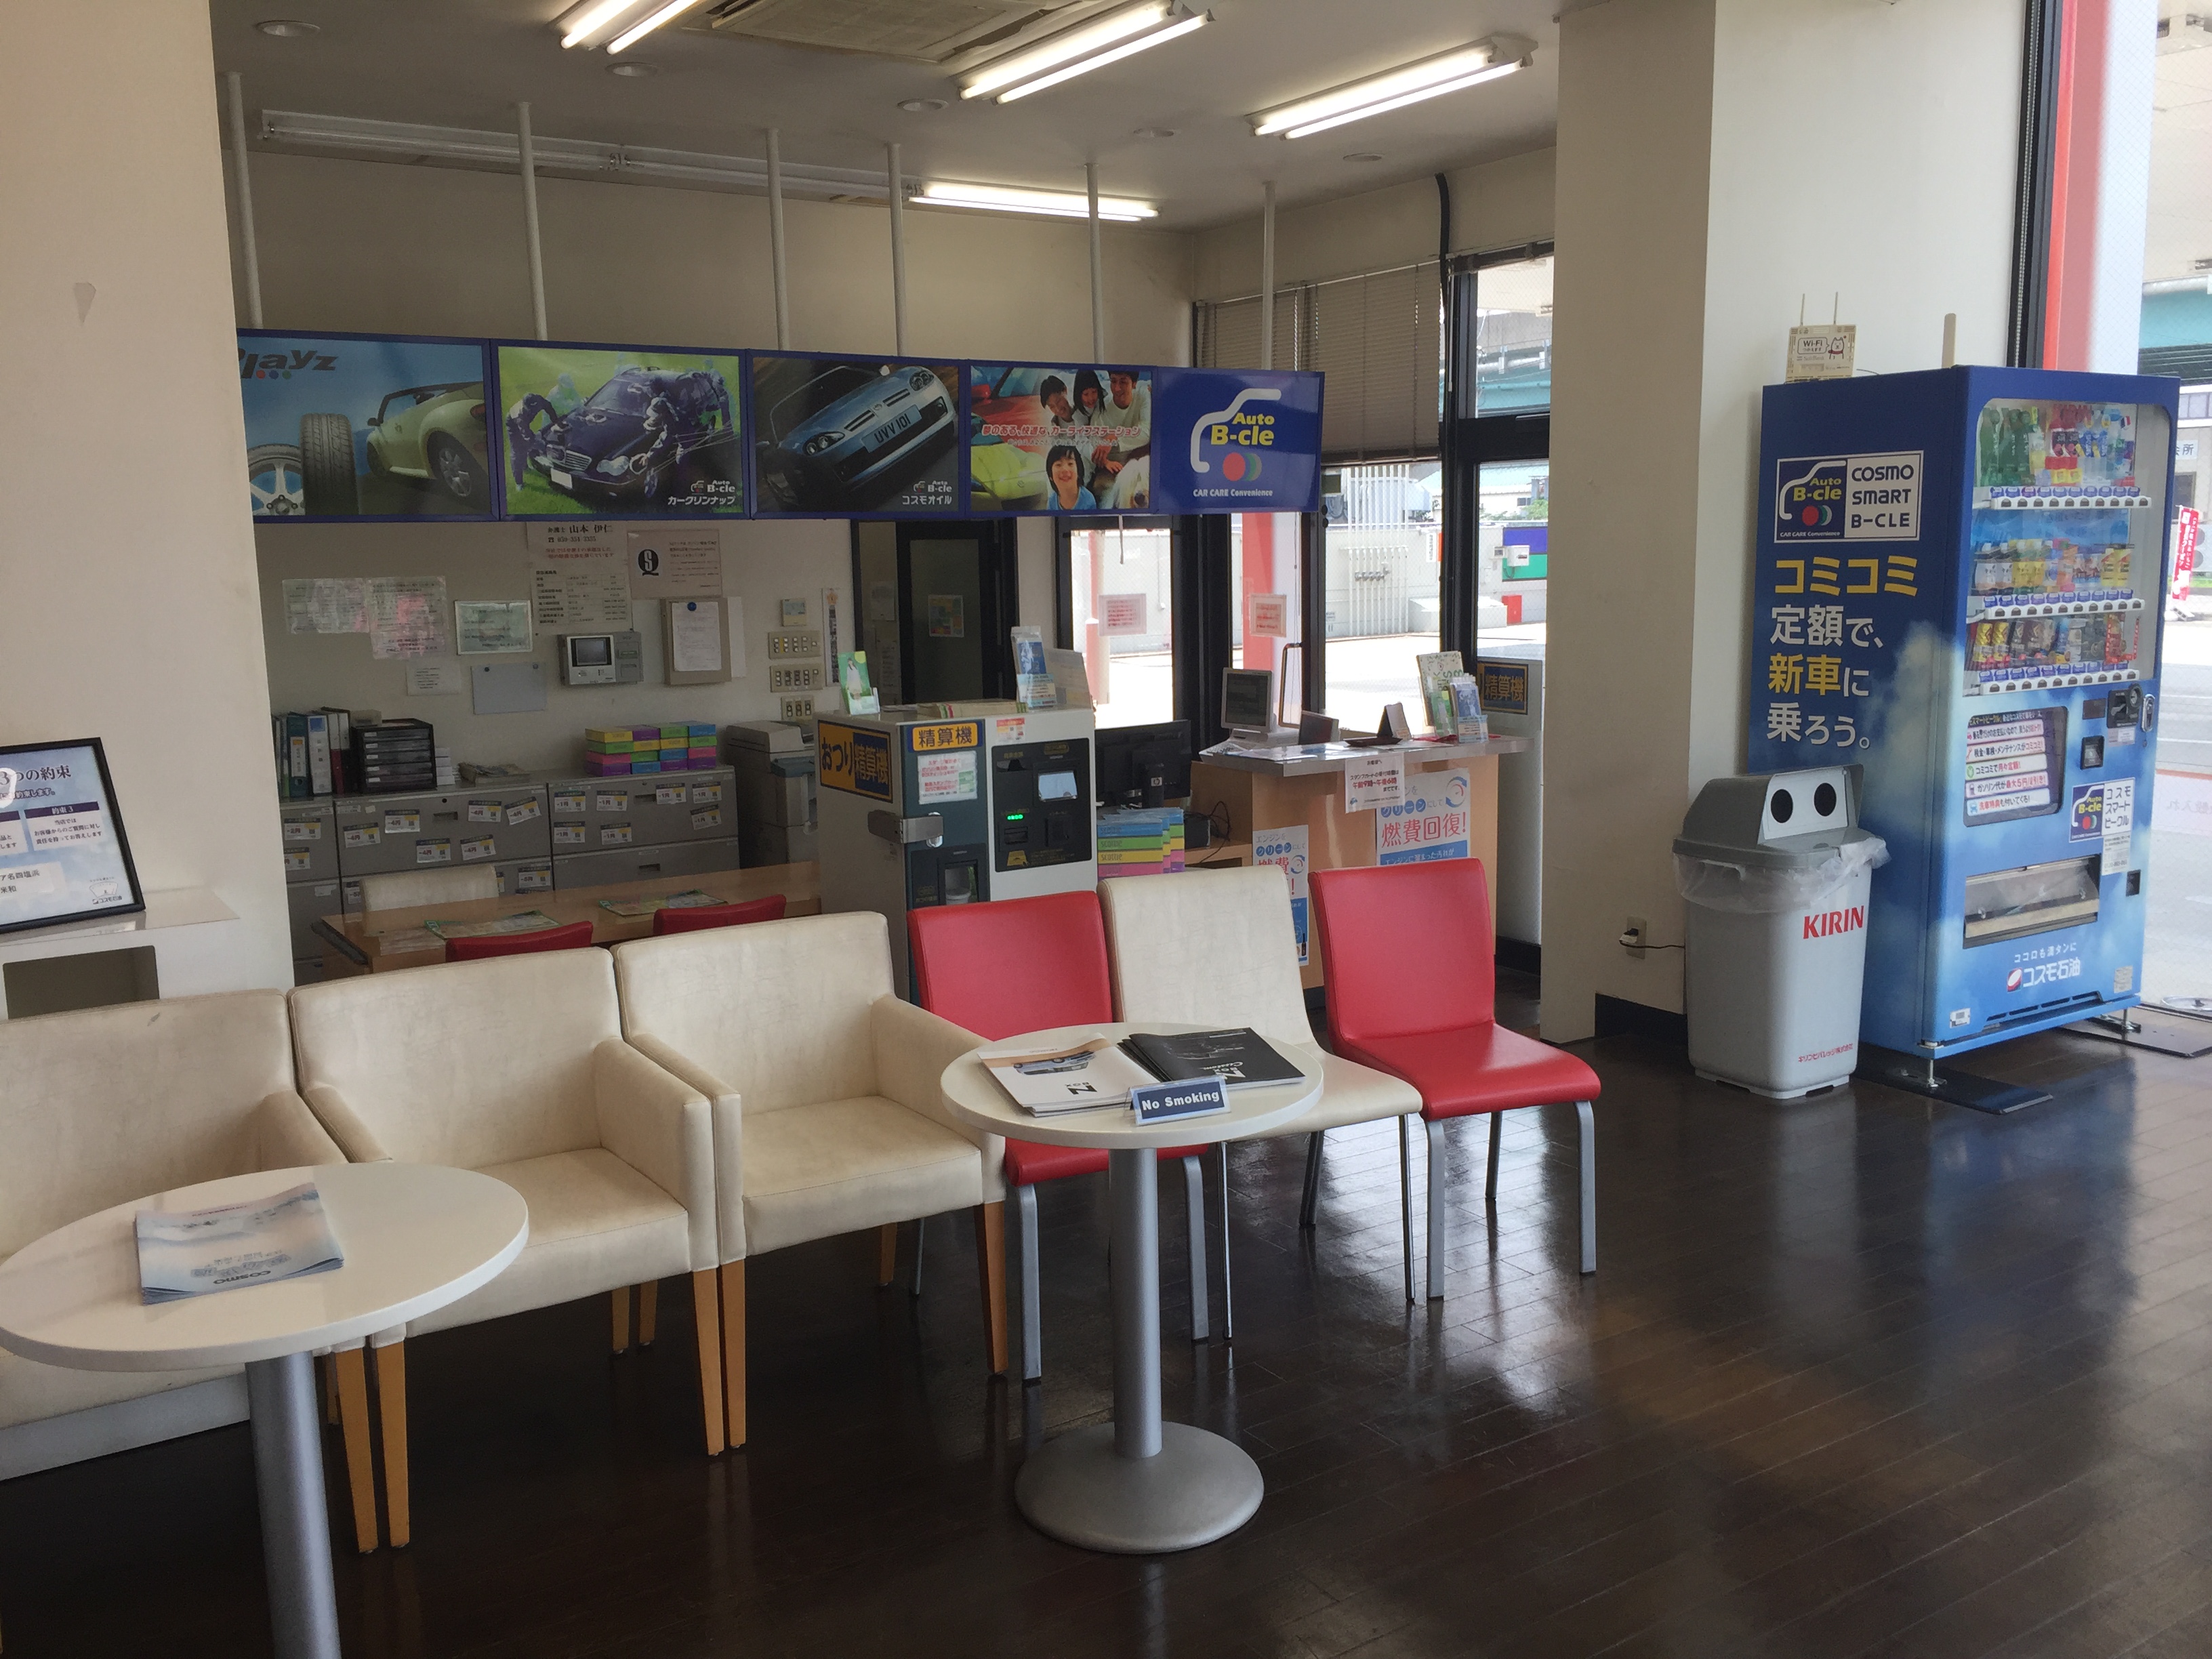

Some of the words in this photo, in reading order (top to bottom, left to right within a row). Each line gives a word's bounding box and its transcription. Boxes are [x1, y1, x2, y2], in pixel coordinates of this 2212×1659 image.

[1231, 412, 1275, 425] Auto
[874, 422, 895, 443] UVV
[1210, 425, 1274, 445] B-cle
[707, 485, 735, 493] B-cle
[927, 485, 952, 493] B-cle
[1809, 477, 1842, 486] Auto
[668, 495, 736, 505] カークリンナップ
[902, 495, 952, 505] コスモオイル
[1193, 489, 1208, 497] CAR
[1210, 489, 1229, 497] CARE
[1231, 489, 1273, 497] Convenience
[1793, 486, 1842, 501] B-cle
[1851, 512, 1910, 529] B-CLE
[569, 525, 588, 533] 山本
[1774, 554, 1918, 596] コミコミ
[1769, 604, 1883, 648] 定額で、
[1767, 653, 1869, 697] 新車に
[1766, 702, 1870, 749] 乗ろう。
[918, 726, 972, 747] 精算機
[2106, 786, 2131, 800] コスモ
[2078, 802, 2102, 814] B-cle
[2106, 800, 2131, 814] スマート
[1381, 811, 1466, 848] 燃費回復!
[2104, 815, 2129, 828] ビークル
[1803, 905, 1864, 939] KIRIN
[2014, 942, 2076, 963] ココロも満タンに
[2022, 956, 2081, 988] コスモ石油
[1141, 1100, 1160, 1110] No
[1164, 1092, 1219, 1107] Smoking
